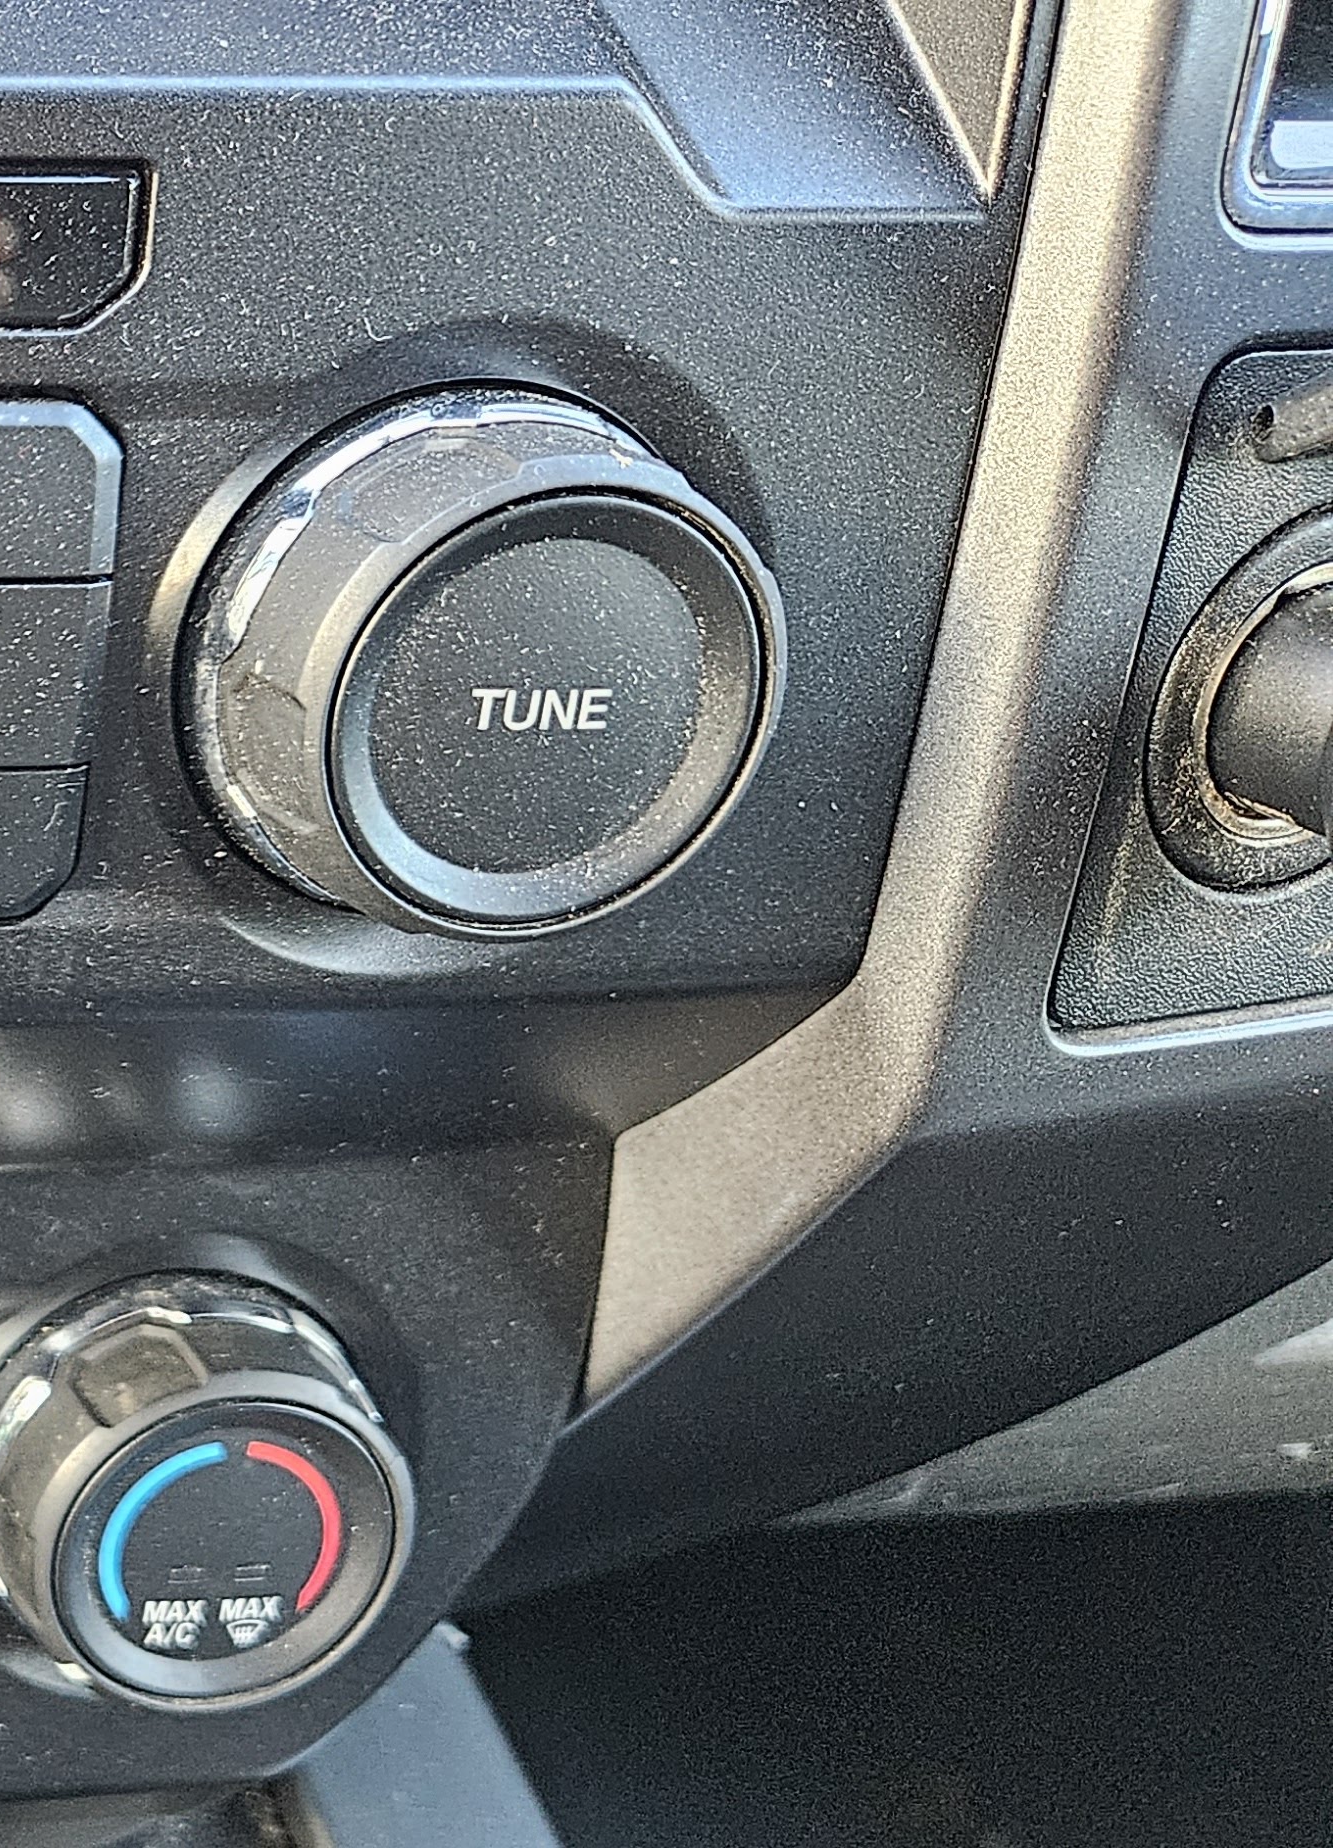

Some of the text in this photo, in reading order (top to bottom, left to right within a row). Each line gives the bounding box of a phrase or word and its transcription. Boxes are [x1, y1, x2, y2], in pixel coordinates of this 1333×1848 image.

[471, 688, 614, 732] TUNE
[142, 1600, 208, 1627] MAX
[219, 1595, 283, 1624] MAX
[143, 1622, 200, 1650] A/C
